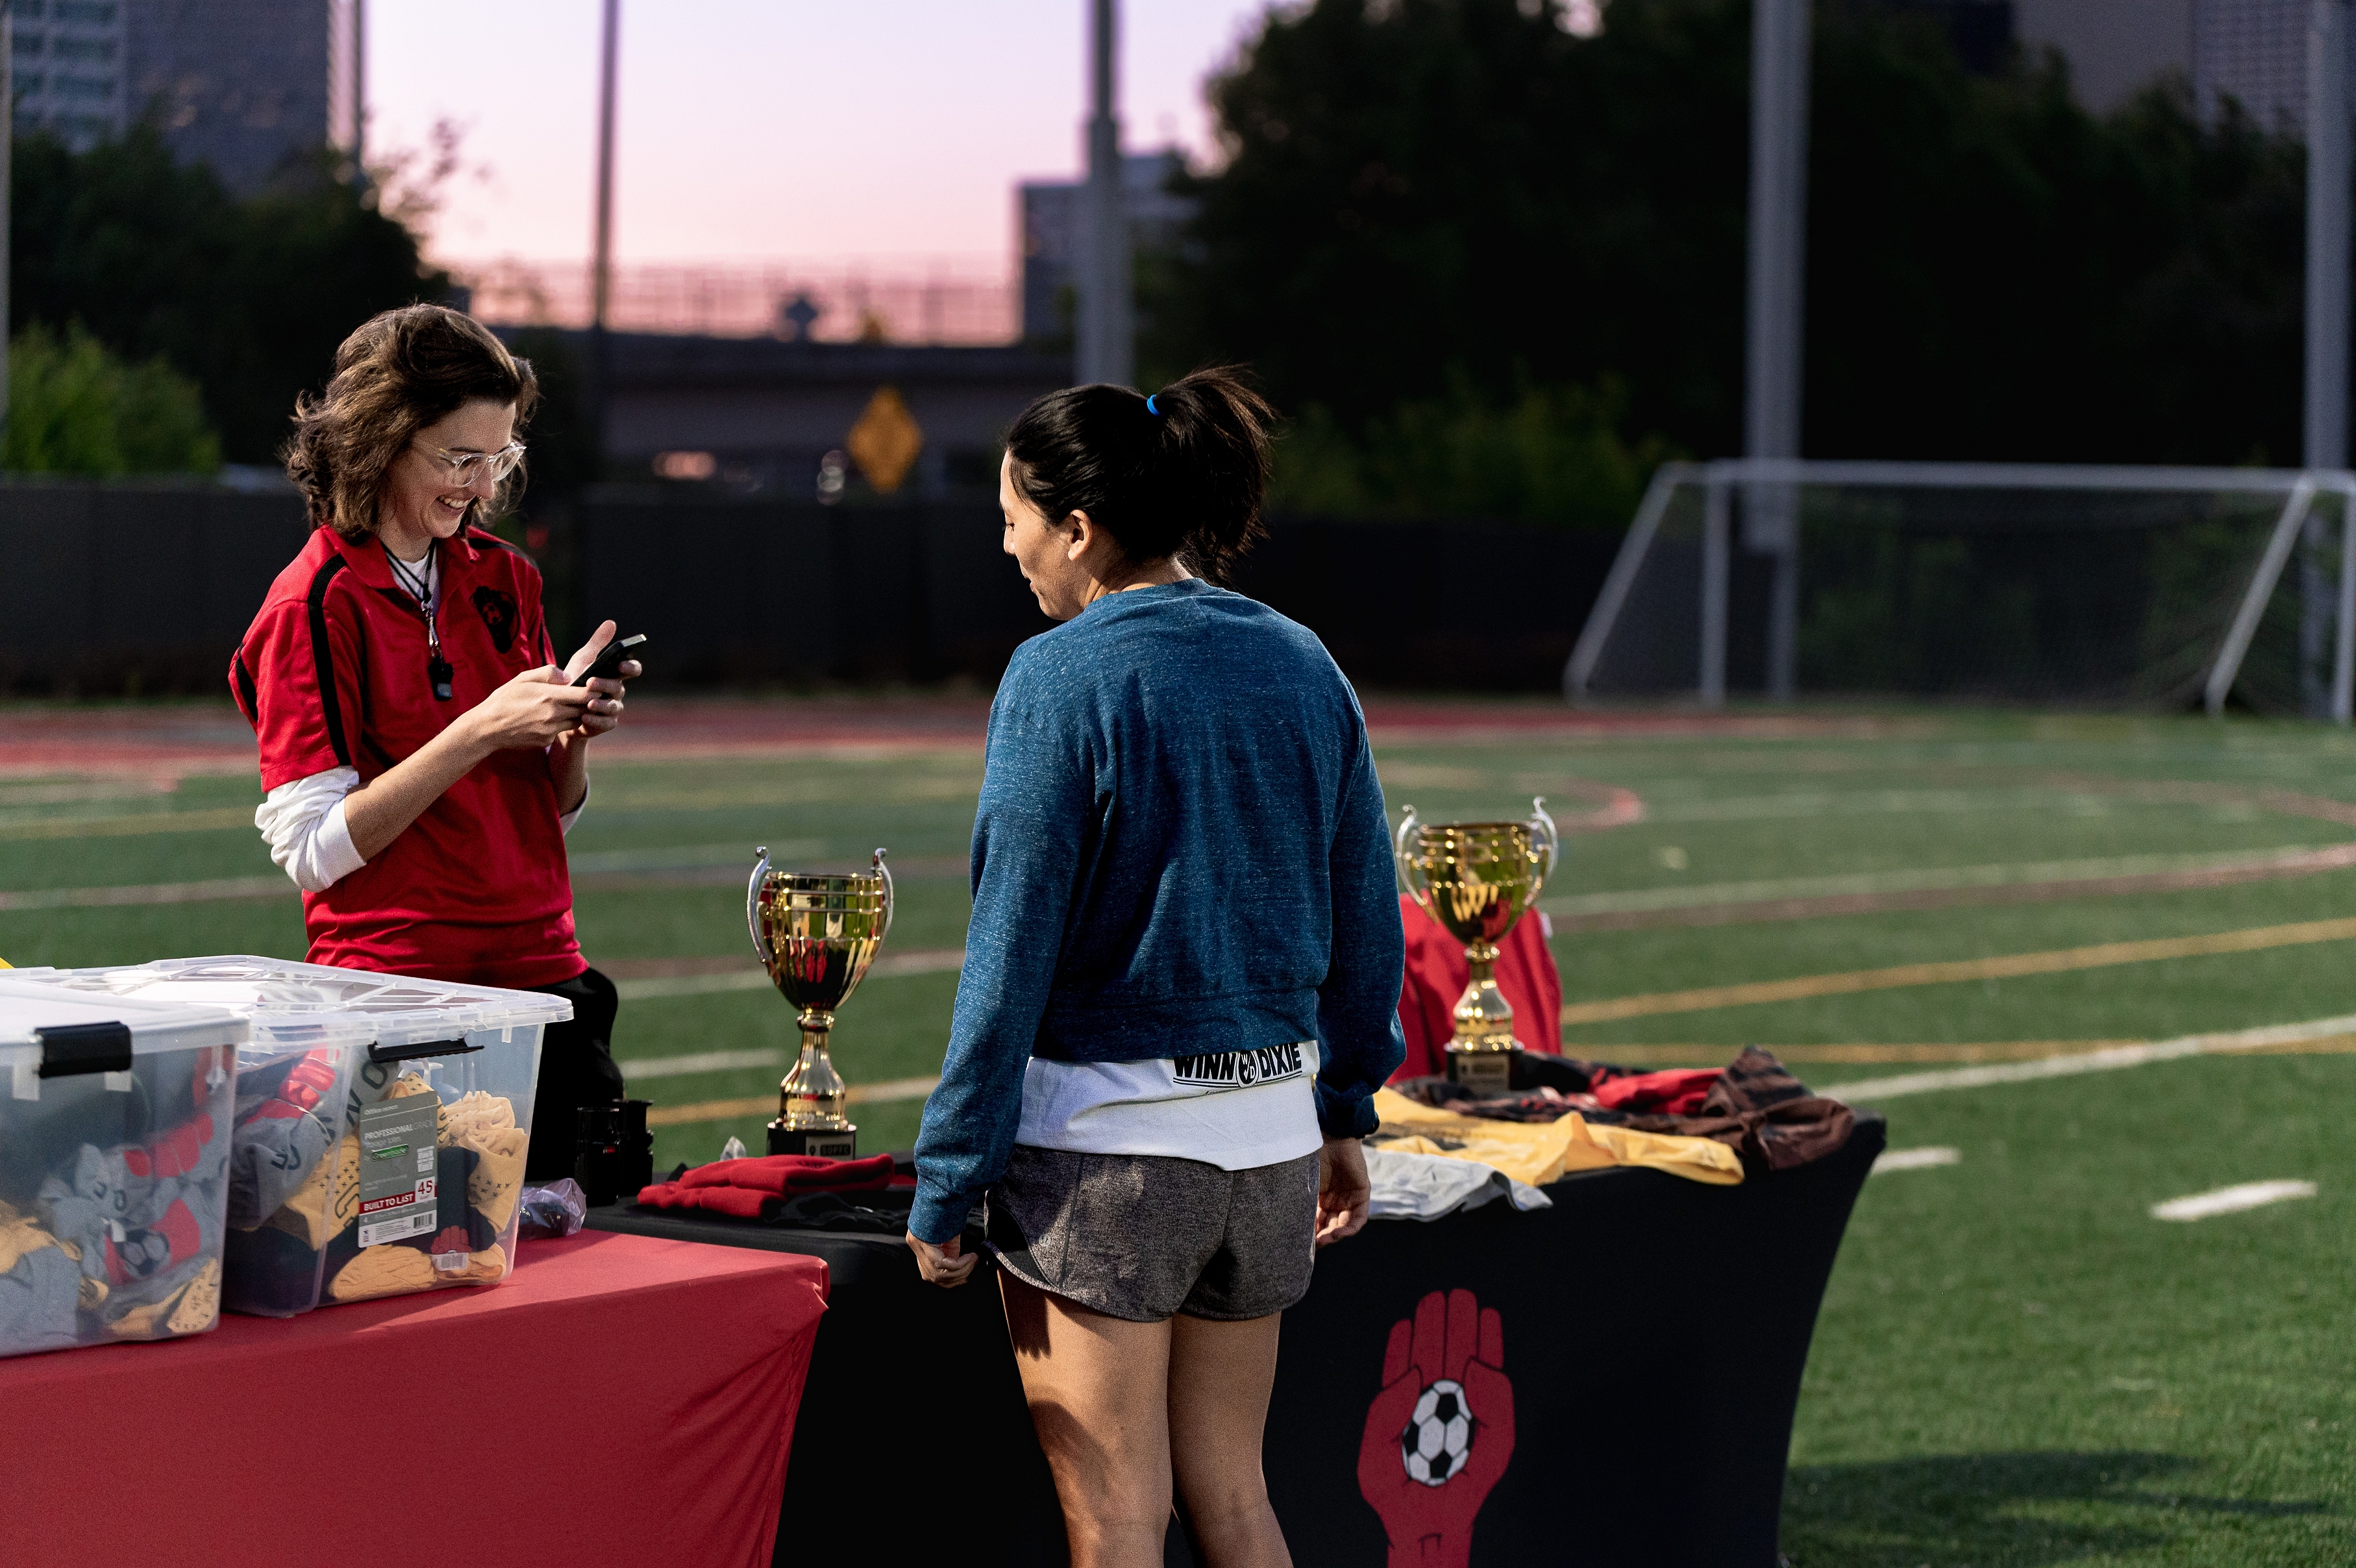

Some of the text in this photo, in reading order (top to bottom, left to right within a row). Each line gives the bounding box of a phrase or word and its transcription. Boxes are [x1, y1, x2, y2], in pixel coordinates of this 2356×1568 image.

[1173, 1052, 1237, 1080] WINN
[1256, 1042, 1302, 1078] DIXIE
[364, 1124, 413, 1140] PROFESSIONAL
[417, 1180, 432, 1195] 45
[364, 1194, 414, 1211] BUILT TO LAST
